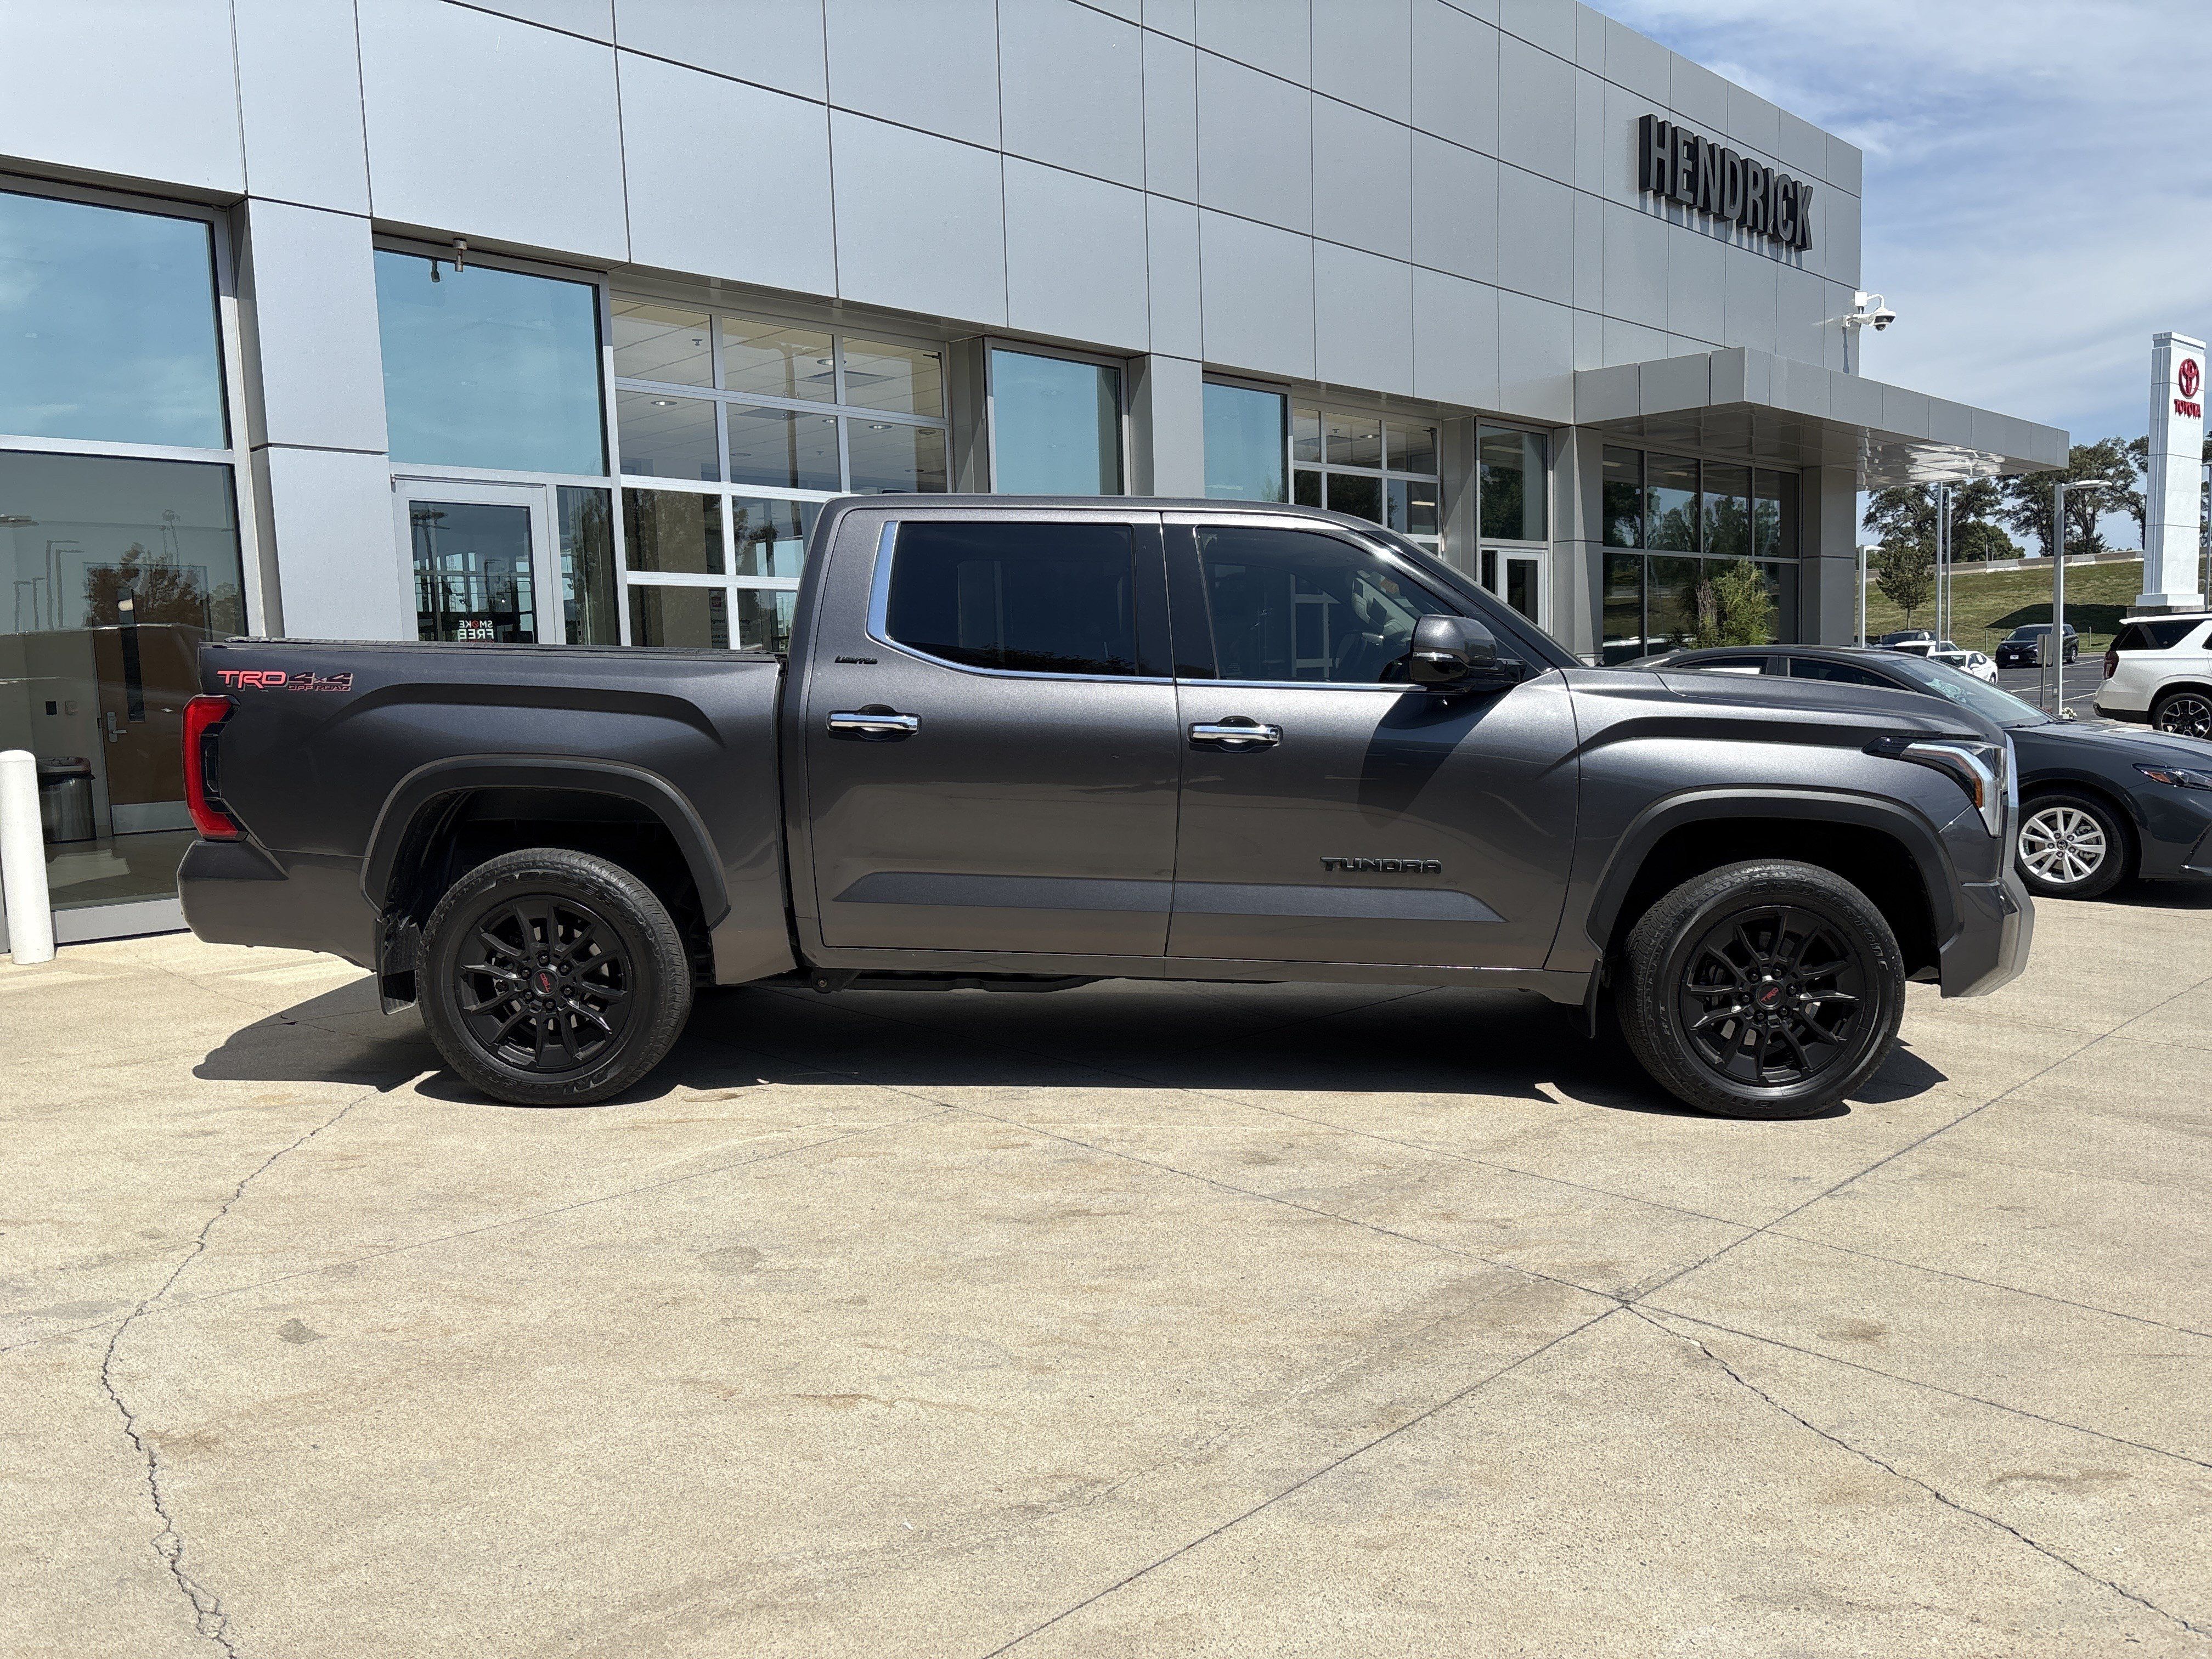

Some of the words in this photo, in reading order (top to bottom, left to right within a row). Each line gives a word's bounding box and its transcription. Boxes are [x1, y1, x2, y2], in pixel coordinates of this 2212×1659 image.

[1639, 114, 1813, 251] HENDRICK
[2174, 399, 2202, 417] TOYOTA
[217, 670, 288, 692] TRD
[1320, 856, 1442, 874] TUNDRA
[1751, 882, 1888, 971] BRIDGESTONE
